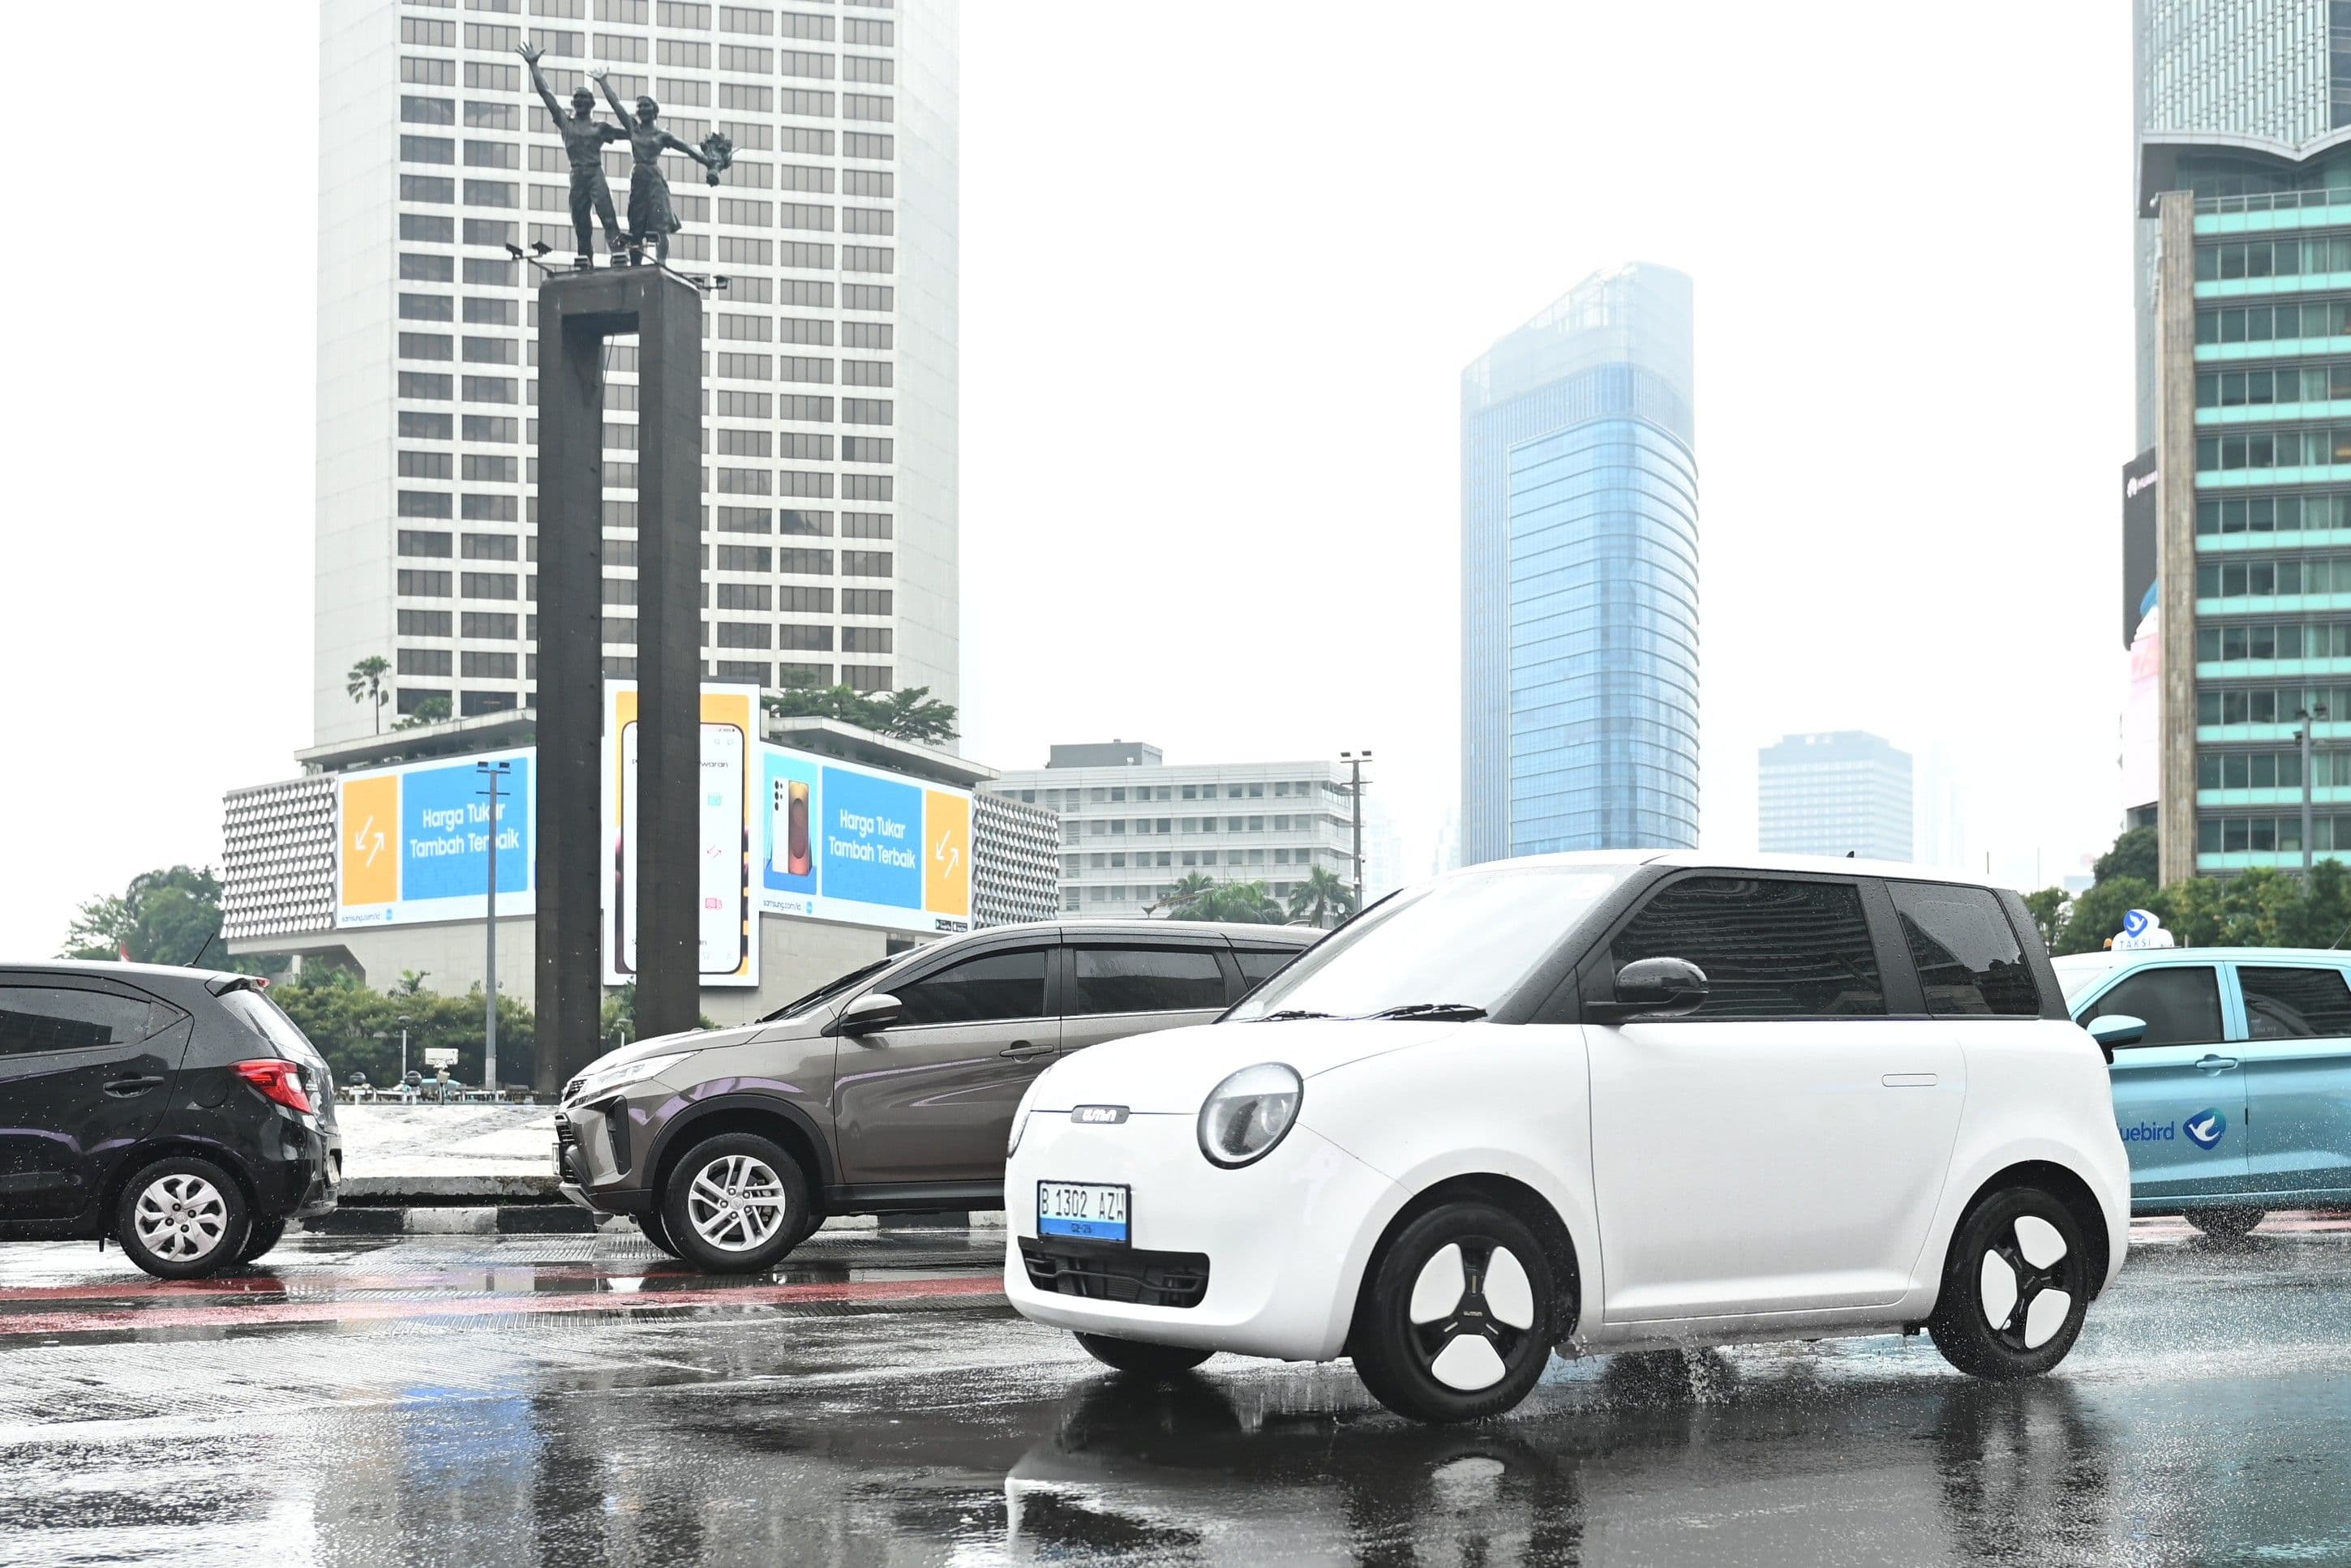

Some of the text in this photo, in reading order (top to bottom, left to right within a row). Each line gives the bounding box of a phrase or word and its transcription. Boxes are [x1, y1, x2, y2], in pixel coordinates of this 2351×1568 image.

[423, 808, 464, 832] Harga
[839, 808, 906, 839] Harga Tukar
[410, 827, 520, 859] Tambah Teraik
[828, 835, 916, 869] Tambah Terbaik
[2119, 937, 2151, 949] TAKSI
[2117, 1120, 2175, 1142] uebird
[1041, 1188, 1049, 1215] B
[1055, 1189, 1088, 1219] 1302
